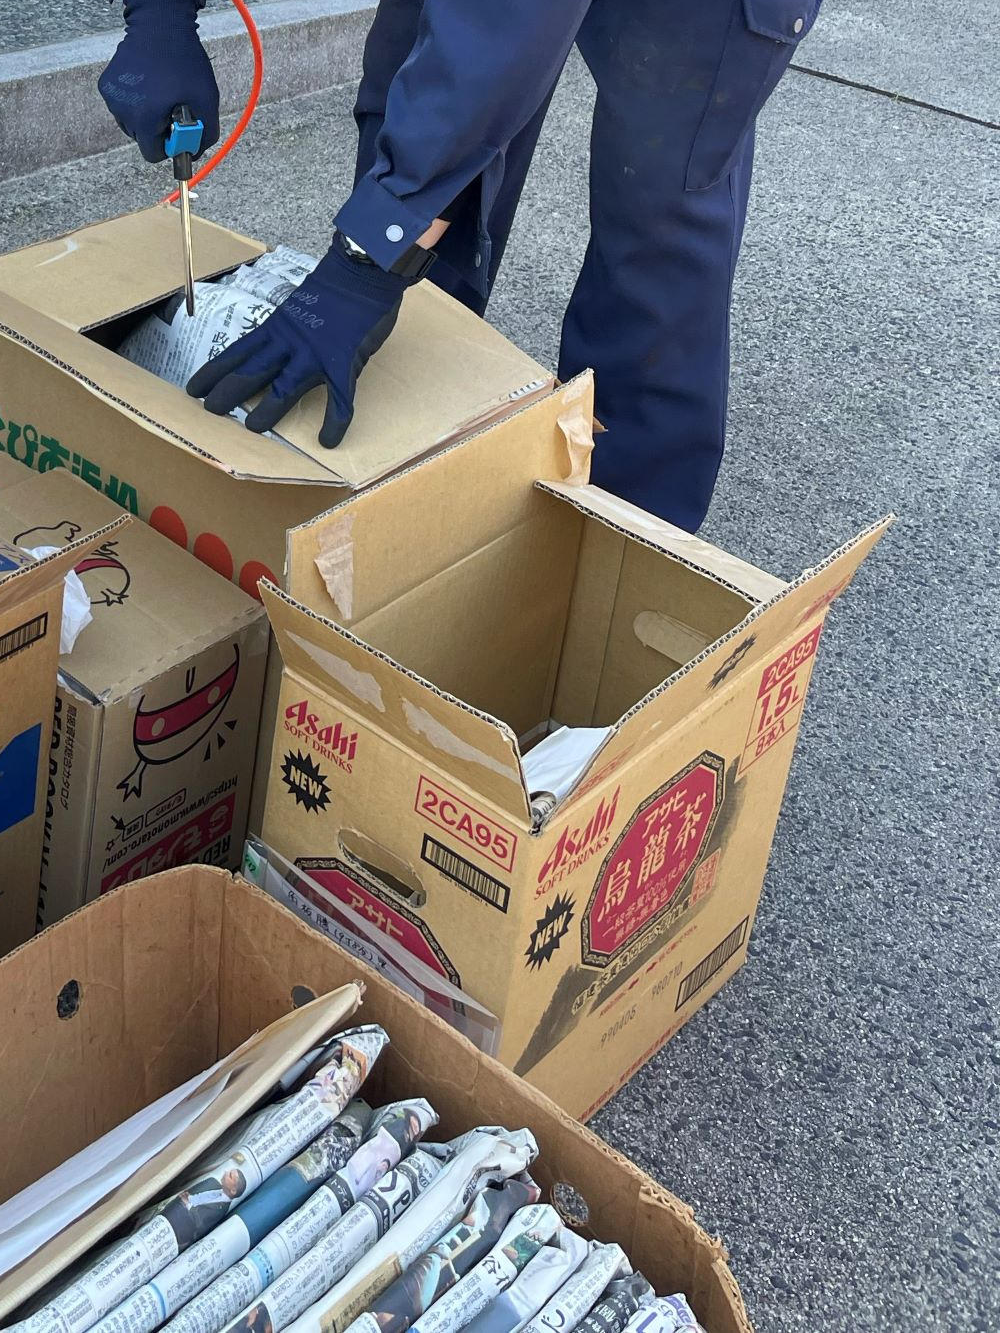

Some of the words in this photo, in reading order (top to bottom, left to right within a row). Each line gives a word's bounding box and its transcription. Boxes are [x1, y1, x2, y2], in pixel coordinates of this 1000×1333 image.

[764, 633, 816, 692] 2CA95
[286, 700, 358, 761] Asahi
[757, 671, 800, 734] 1.5L
[283, 720, 310, 745] SOFT
[312, 740, 353, 775] DRINKS
[755, 719, 786, 757] 8本入
[290, 767, 323, 801] NEW
[641, 788, 688, 840] アサヒ
[102, 774, 238, 873] https://www.monotaro.com/
[422, 789, 509, 860] 2CA95
[538, 784, 621, 884] Asahi
[534, 870, 566, 901] SOFT
[567, 831, 611, 878] DRINKS
[533, 909, 570, 955] NEW
